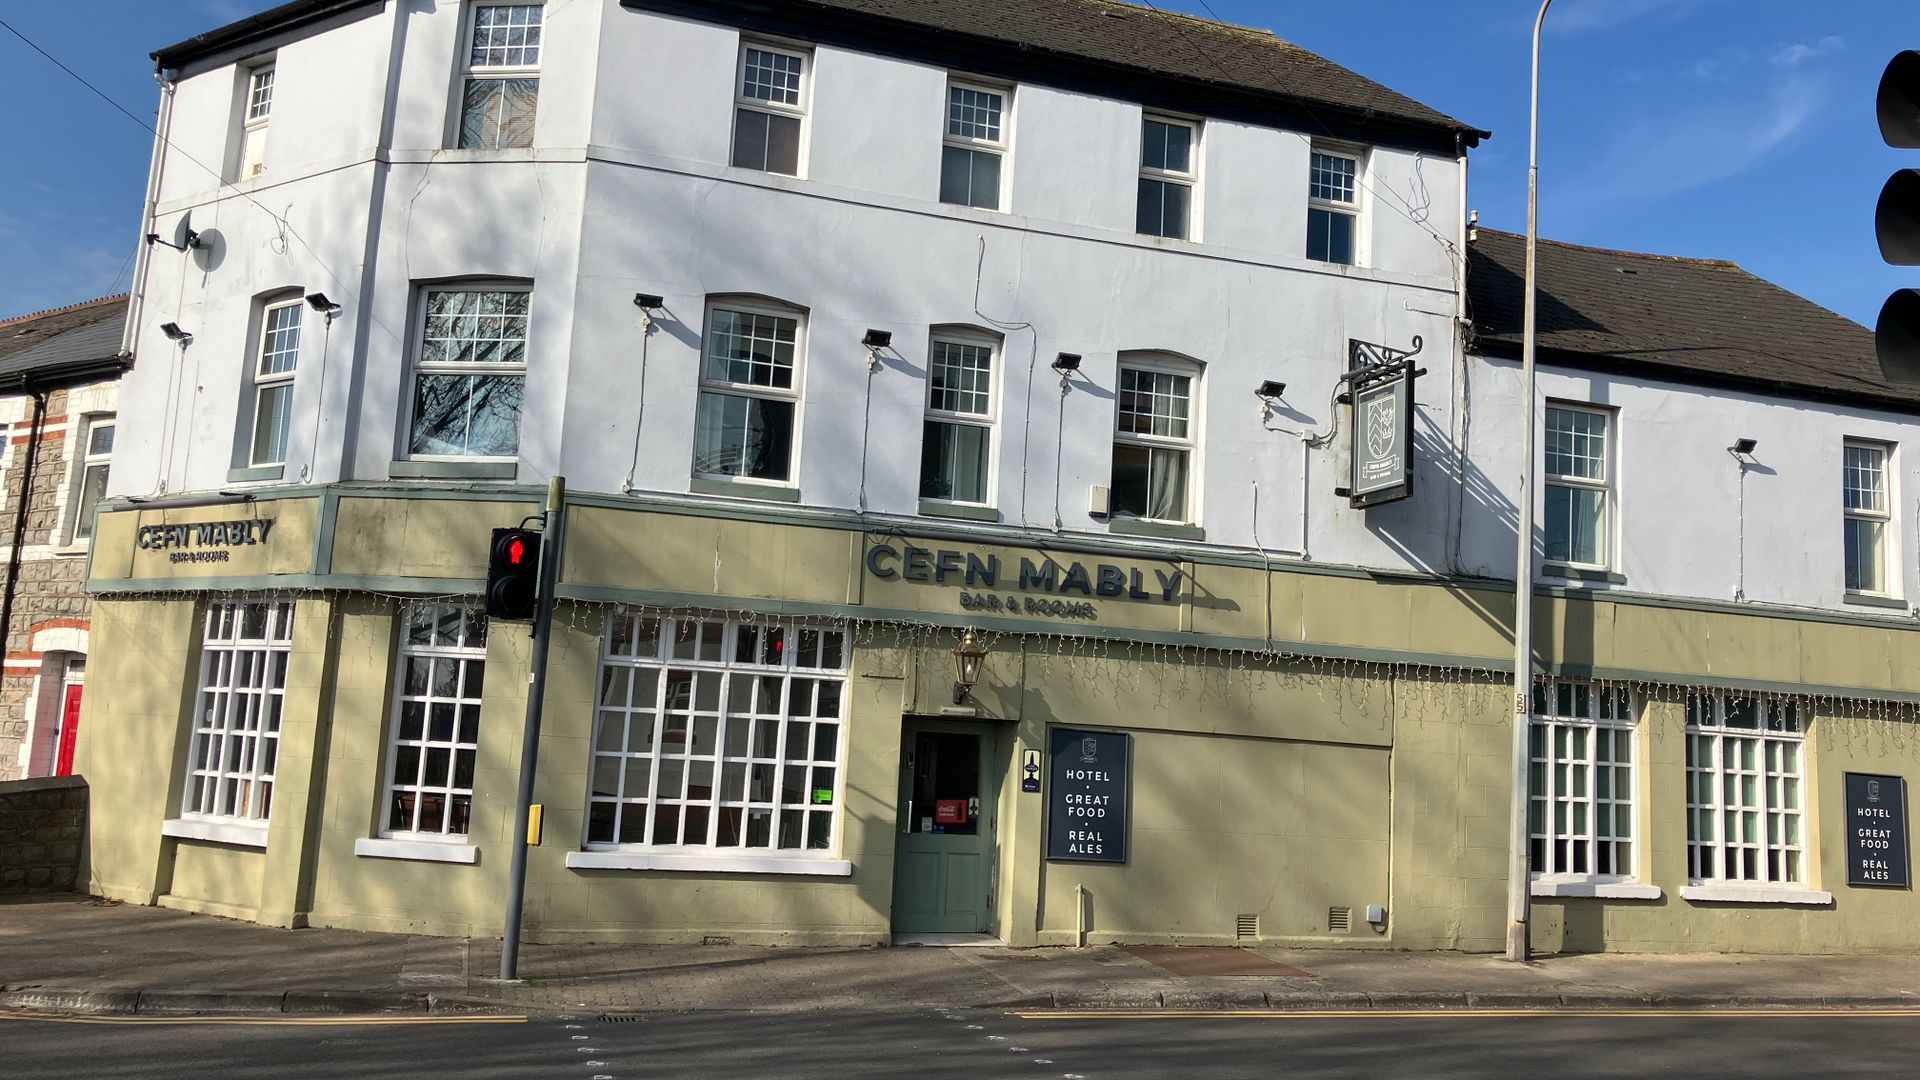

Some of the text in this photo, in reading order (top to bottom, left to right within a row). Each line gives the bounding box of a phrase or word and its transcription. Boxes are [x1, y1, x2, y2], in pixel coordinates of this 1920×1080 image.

[136, 520, 271, 549] CEFN MABLY
[169, 552, 187, 563] BAR
[195, 550, 229, 562] ROOMS
[866, 543, 1182, 601] CEFN MABLY
[959, 592, 1093, 615] BAR & ROOMS
[1066, 769, 1110, 781] HOTEL
[1065, 794, 1109, 805] GREAT
[1068, 807, 1105, 818] FOOD
[1857, 808, 1891, 818] HOTEL
[1069, 830, 1103, 842] REAL
[1858, 828, 1891, 838] GREAT
[1068, 843, 1103, 854] ALES
[1860, 839, 1889, 849] FOOD
[1862, 859, 1889, 869] REAL
[1863, 870, 1889, 880] ALES
